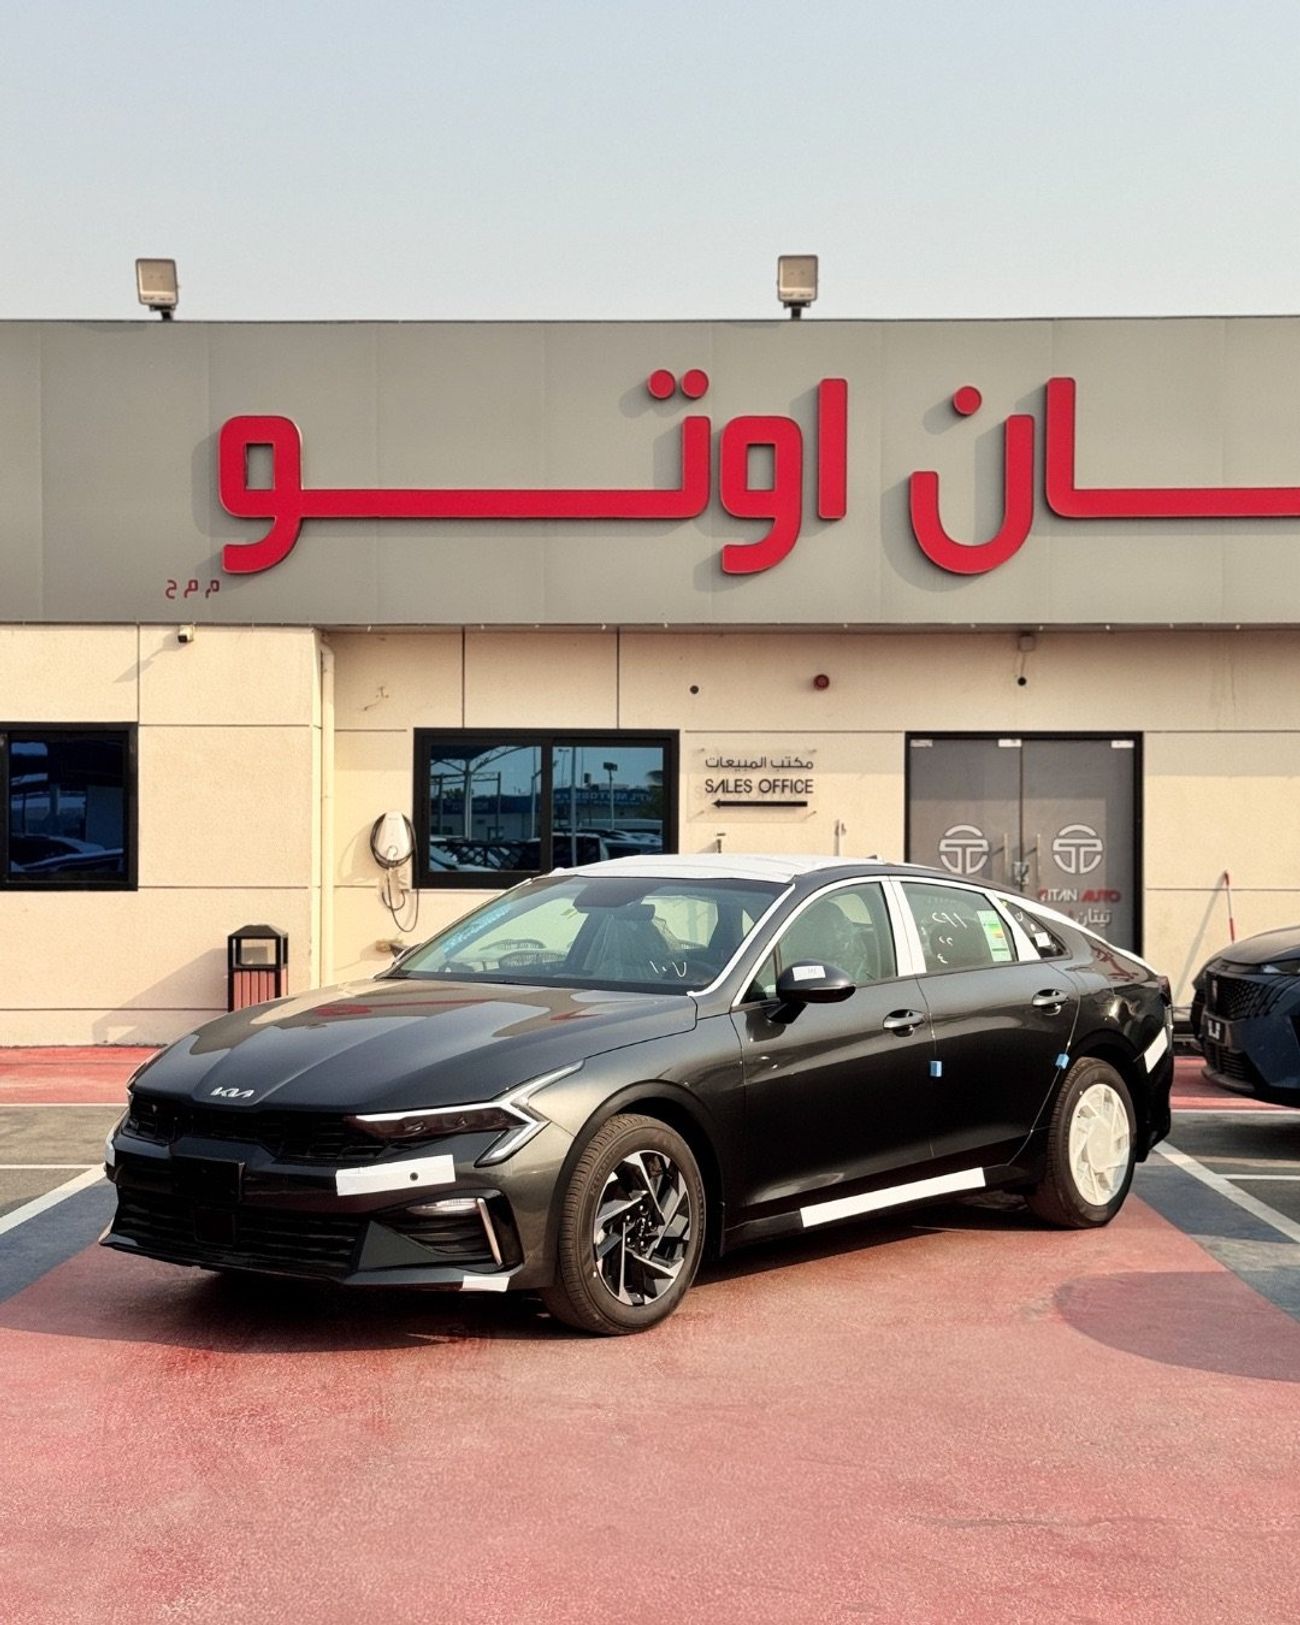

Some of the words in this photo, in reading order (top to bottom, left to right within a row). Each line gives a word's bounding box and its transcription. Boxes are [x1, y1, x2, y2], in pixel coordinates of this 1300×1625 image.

[219, 369, 848, 575] اوتو
[705, 756, 767, 772] المبيعات
[770, 756, 814, 772] مكتب
[705, 778, 753, 794] SALES
[758, 778, 814, 794] OFFICE
[1080, 889, 1121, 903] AUTO
